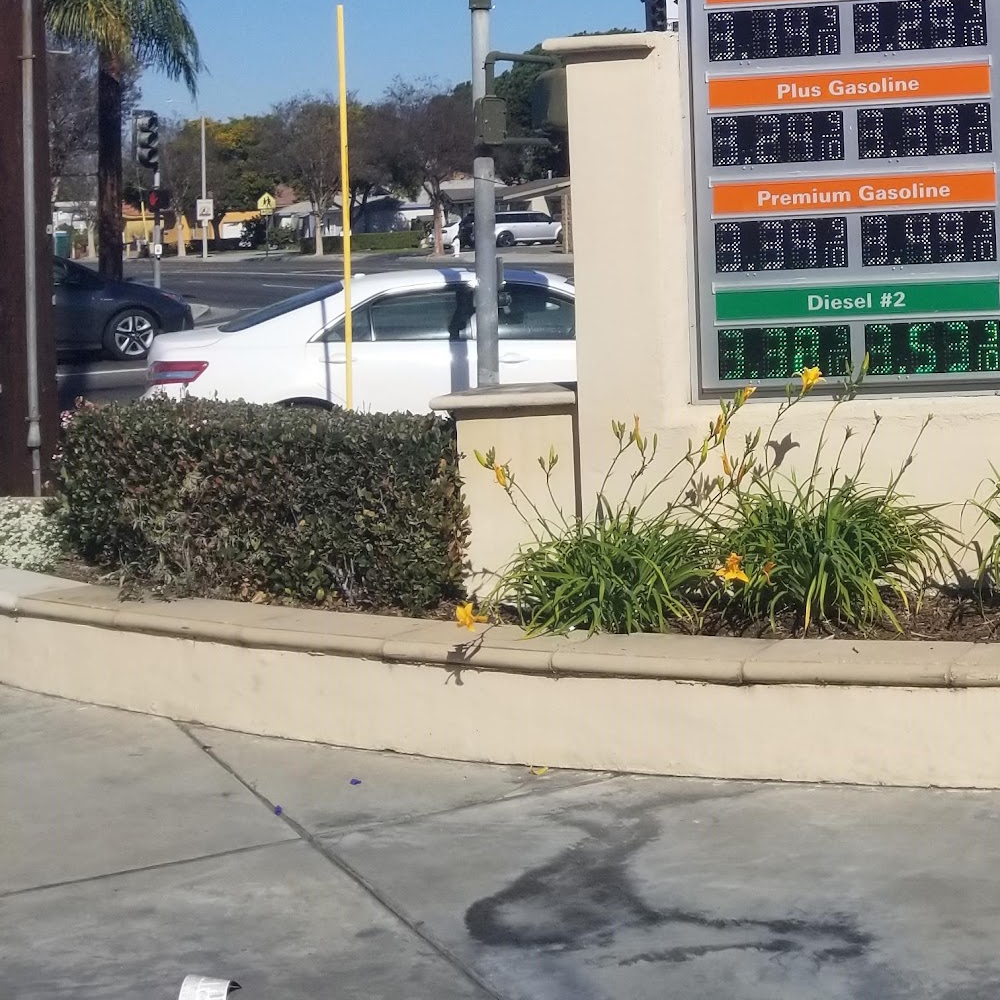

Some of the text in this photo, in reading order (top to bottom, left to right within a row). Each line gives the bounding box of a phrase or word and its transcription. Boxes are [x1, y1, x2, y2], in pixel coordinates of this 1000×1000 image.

[857, 0, 956, 53] 3.29
[777, 76, 920, 99] Plus Gasoline
[861, 104, 961, 158] 3.39
[757, 182, 951, 207] Premium Gasoline
[863, 211, 966, 266] 3.49
[807, 291, 906, 311] Diesel #2
[869, 320, 971, 375] 3.53
